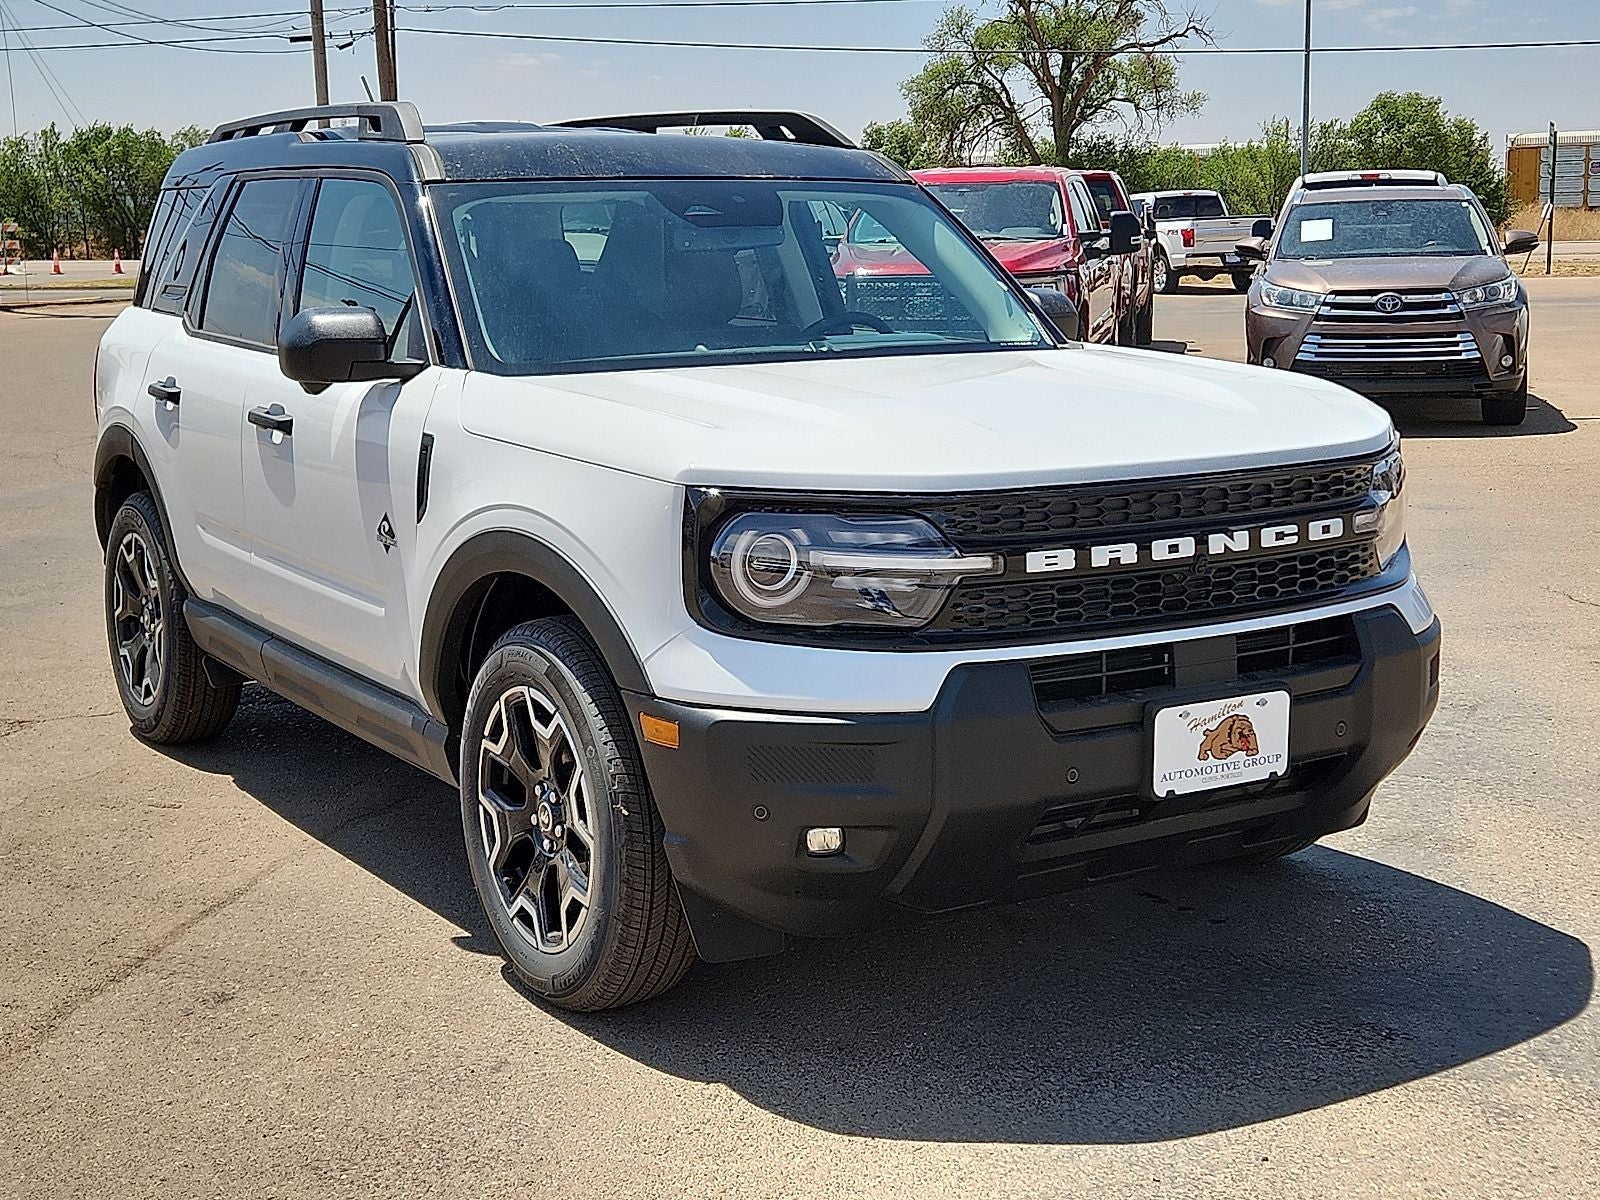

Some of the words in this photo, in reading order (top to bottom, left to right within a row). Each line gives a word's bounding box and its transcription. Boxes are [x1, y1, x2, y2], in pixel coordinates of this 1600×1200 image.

[1025, 517, 1344, 574] BRONCO
[1187, 700, 1244, 733] Hamilton
[1160, 761, 1241, 783] AUTOMOTIVE
[1243, 753, 1282, 769] GROUP
